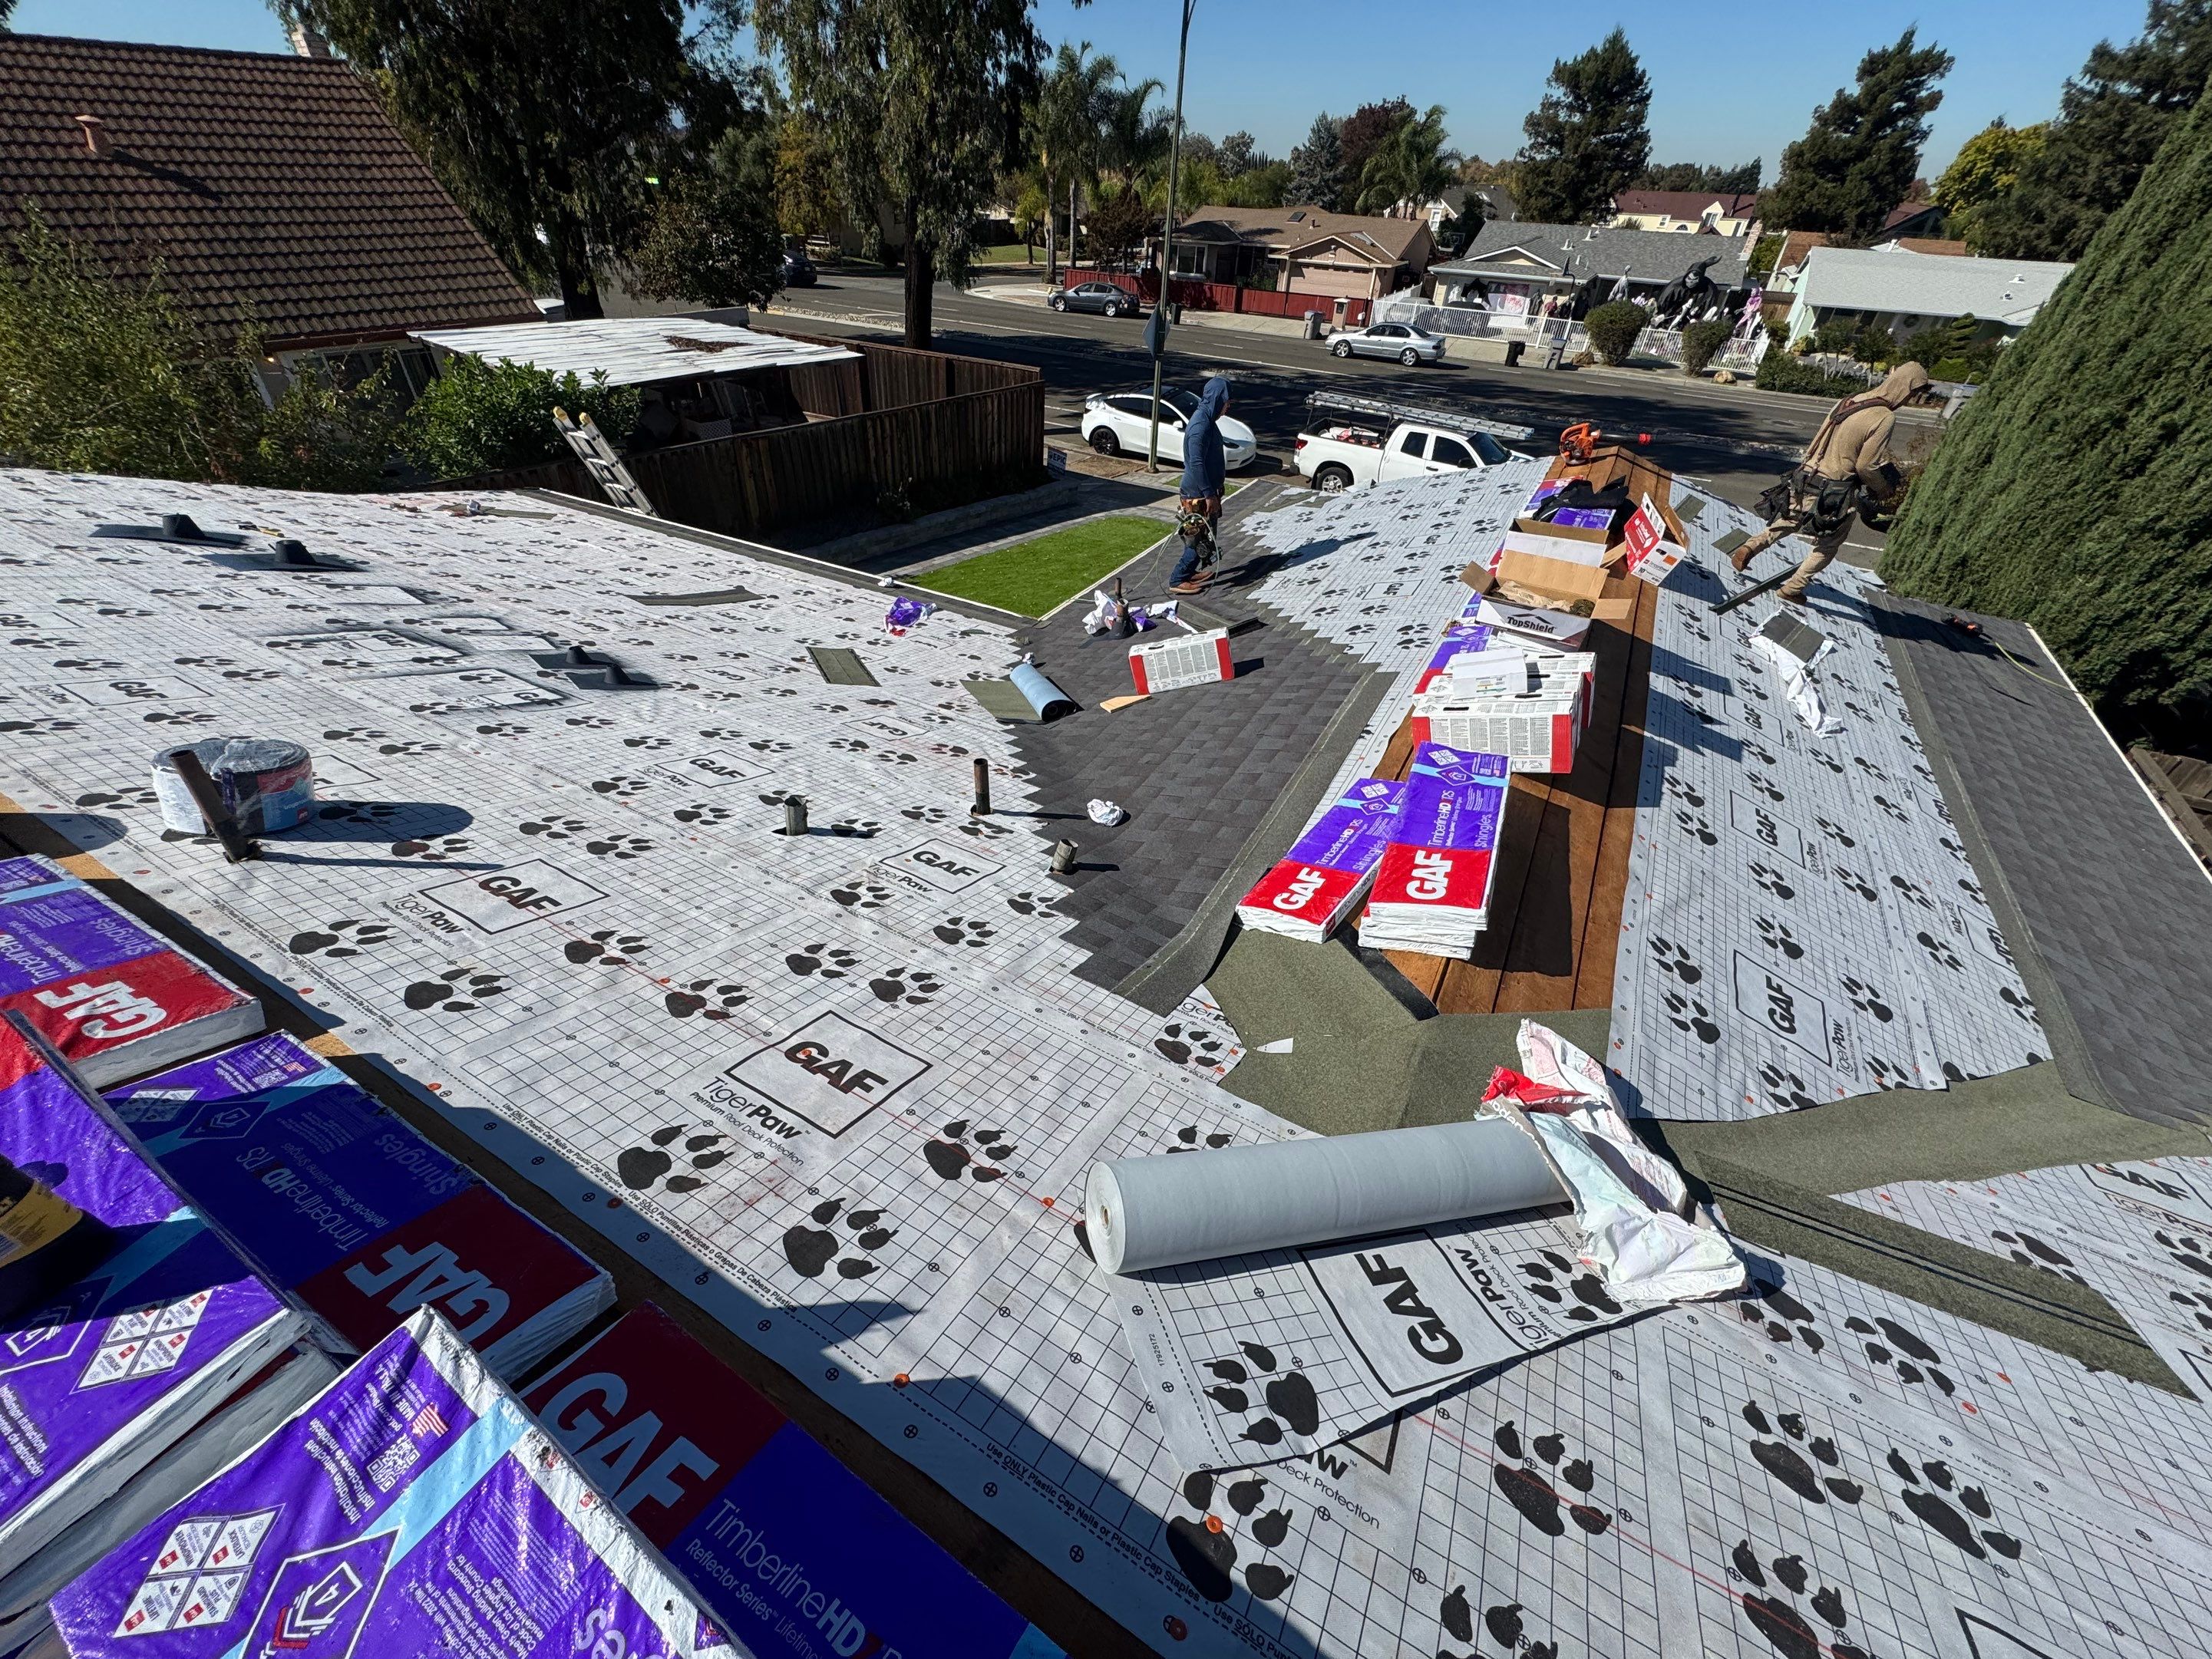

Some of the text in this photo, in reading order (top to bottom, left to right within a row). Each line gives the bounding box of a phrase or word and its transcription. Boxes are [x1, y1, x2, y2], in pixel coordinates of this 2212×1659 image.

[1507, 616, 1554, 634] TopShield
[1744, 703, 1762, 730] GAF
[689, 758, 747, 779] GAF
[1474, 814, 1491, 848] Shingles
[1755, 808, 1778, 846] GAF
[913, 849, 981, 879] GAF
[1405, 849, 1454, 900] GAF
[478, 876, 563, 912] GAF
[1273, 867, 1326, 910] GAF
[32, 981, 167, 1038] GAF
[1765, 975, 1797, 1034] GAF
[784, 1041, 889, 1095] GAF
[502, 1103, 624, 1189] Use ONLY Plastic Cap Nails or Plastic Cap Staples
[688, 1091, 804, 1167] Premium Roof Deck Protection
[236, 1146, 275, 1173] RS
[374, 1133, 458, 1195] Shingles
[350, 1202, 389, 1229] Reflector
[628, 1190, 641, 1202] Use
[657, 1209, 683, 1231] Puntillas
[714, 1252, 738, 1272] Grapas
[736, 1266, 748, 1278] De
[747, 1273, 771, 1295] Cabeza
[342, 1242, 510, 1343] GAF
[1354, 1252, 1464, 1365] GAF
[1488, 1263, 1510, 1288] Deck
[1507, 1289, 1527, 1310] Roof
[1527, 1311, 1563, 1338] remium
[1149, 1333, 1164, 1368] 17925172
[539, 1372, 719, 1516] GAF
[333, 1470, 362, 1525] Installation
[338, 1455, 376, 1512] Instrucciones
[1276, 1459, 1312, 1486] Deck
[1314, 1477, 1381, 1529] Protection
[986, 1442, 1201, 1602] Use ONLY Plastic Cap Nails or Plastic Cap Staples
[456, 1552, 469, 1567] for
[464, 1562, 484, 1588] County
[685, 1538, 739, 1592] Reflector
[447, 1560, 475, 1595] Standards
[491, 1577, 519, 1608] buildings
[315, 1585, 338, 1606] 4
[423, 1601, 438, 1617] 2022
[447, 1587, 474, 1622] Regulations
[471, 1590, 495, 1622] Building
[484, 1584, 507, 1614] Angeles
[493, 1617, 510, 1641] Green
[502, 1612, 517, 1628] Los
[1213, 1604, 1233, 1624] Use
[475, 1625, 489, 1641] Code
[519, 1631, 537, 1652] Code
